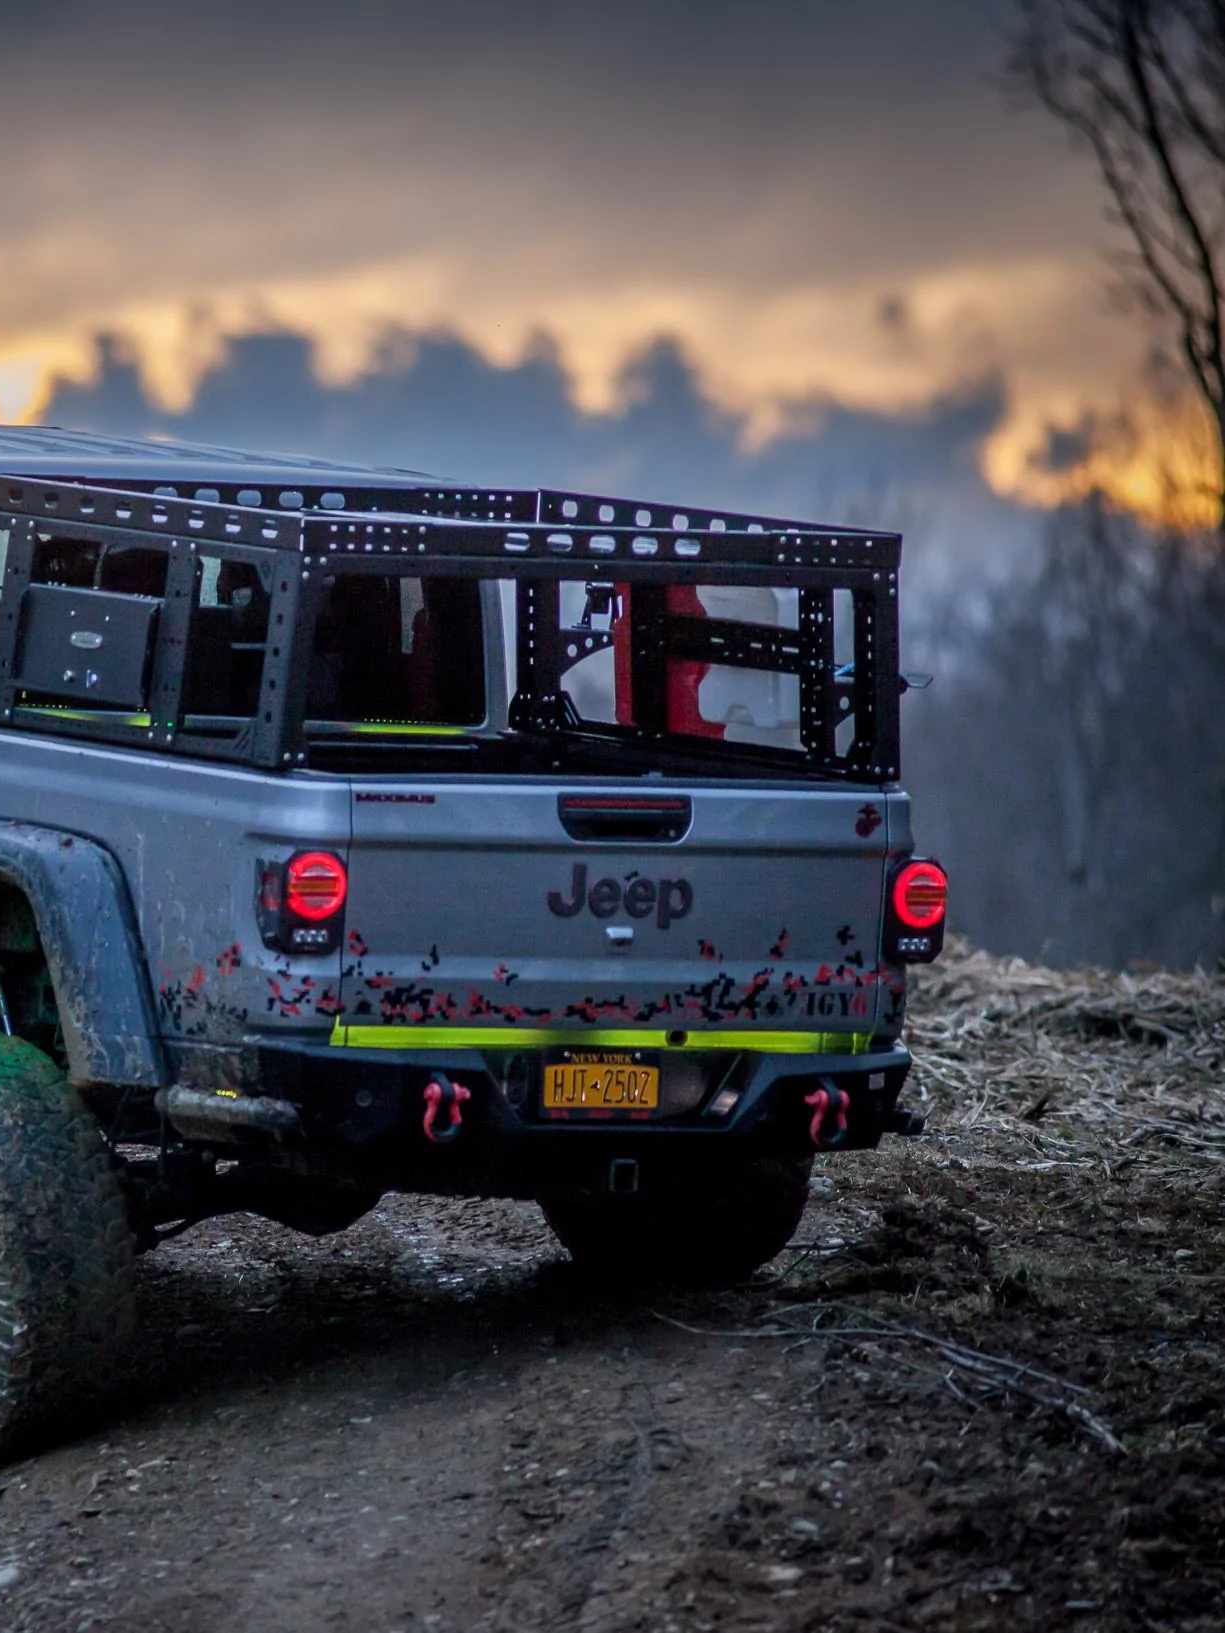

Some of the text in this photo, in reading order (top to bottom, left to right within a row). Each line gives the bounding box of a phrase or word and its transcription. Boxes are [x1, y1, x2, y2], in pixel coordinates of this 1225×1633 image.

[547, 863, 693, 930] Jeep
[571, 1053, 633, 1065] NEW YORK
[553, 1069, 650, 1105] HJT 2502
